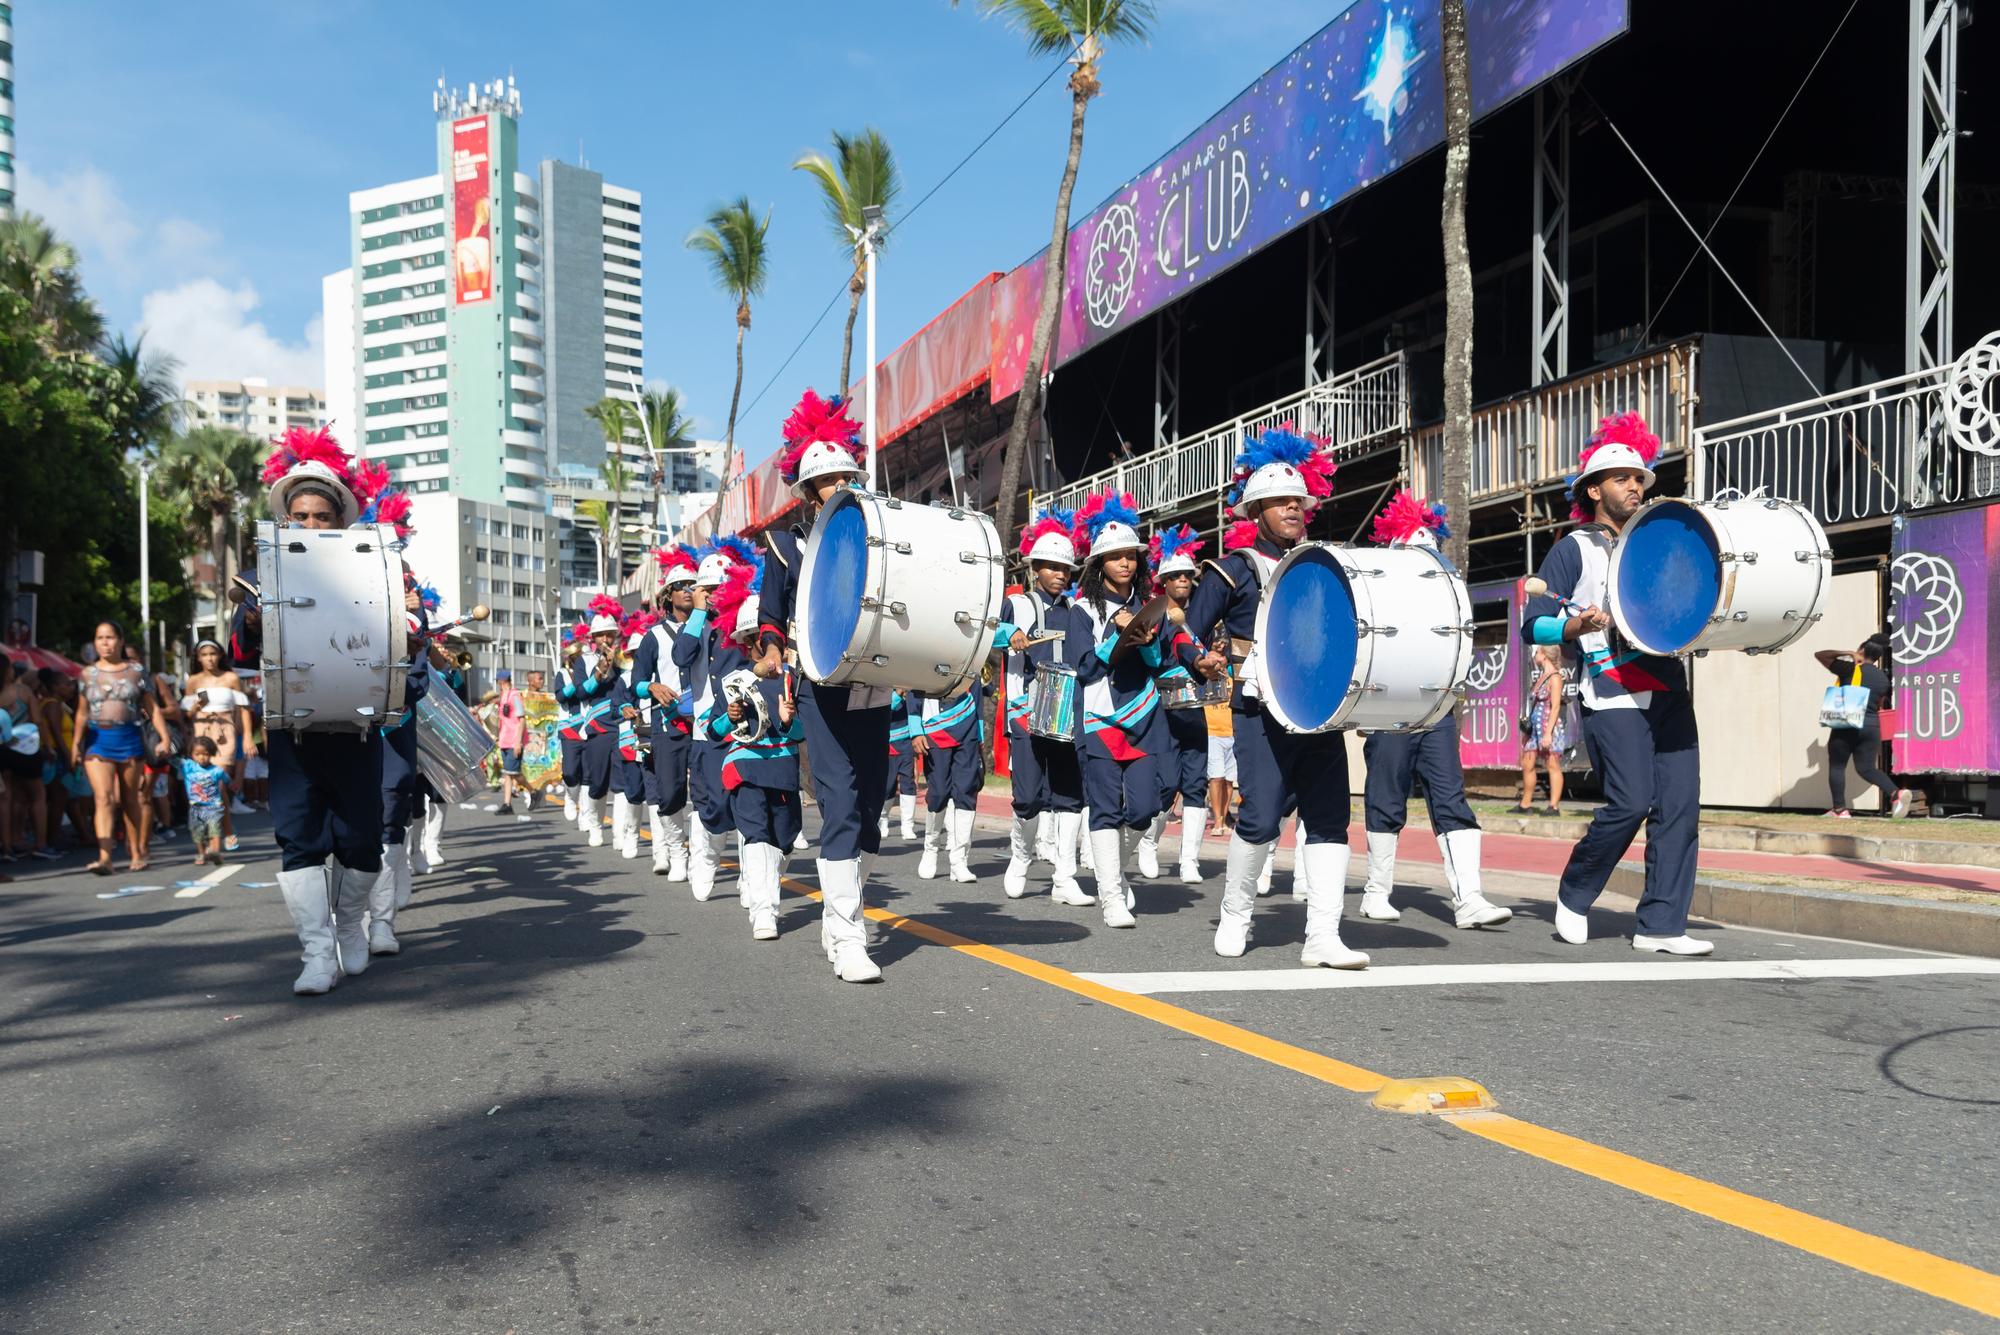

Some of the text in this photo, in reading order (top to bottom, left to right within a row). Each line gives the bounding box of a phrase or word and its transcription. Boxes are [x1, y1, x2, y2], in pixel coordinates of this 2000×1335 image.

[1159, 115, 1251, 195] CAMAROTE
[1158, 150, 1250, 276] CLUB
[1463, 697, 1508, 706] AMAROTE
[1891, 673, 1961, 687] AROTE
[1891, 688, 1960, 737] LUB
